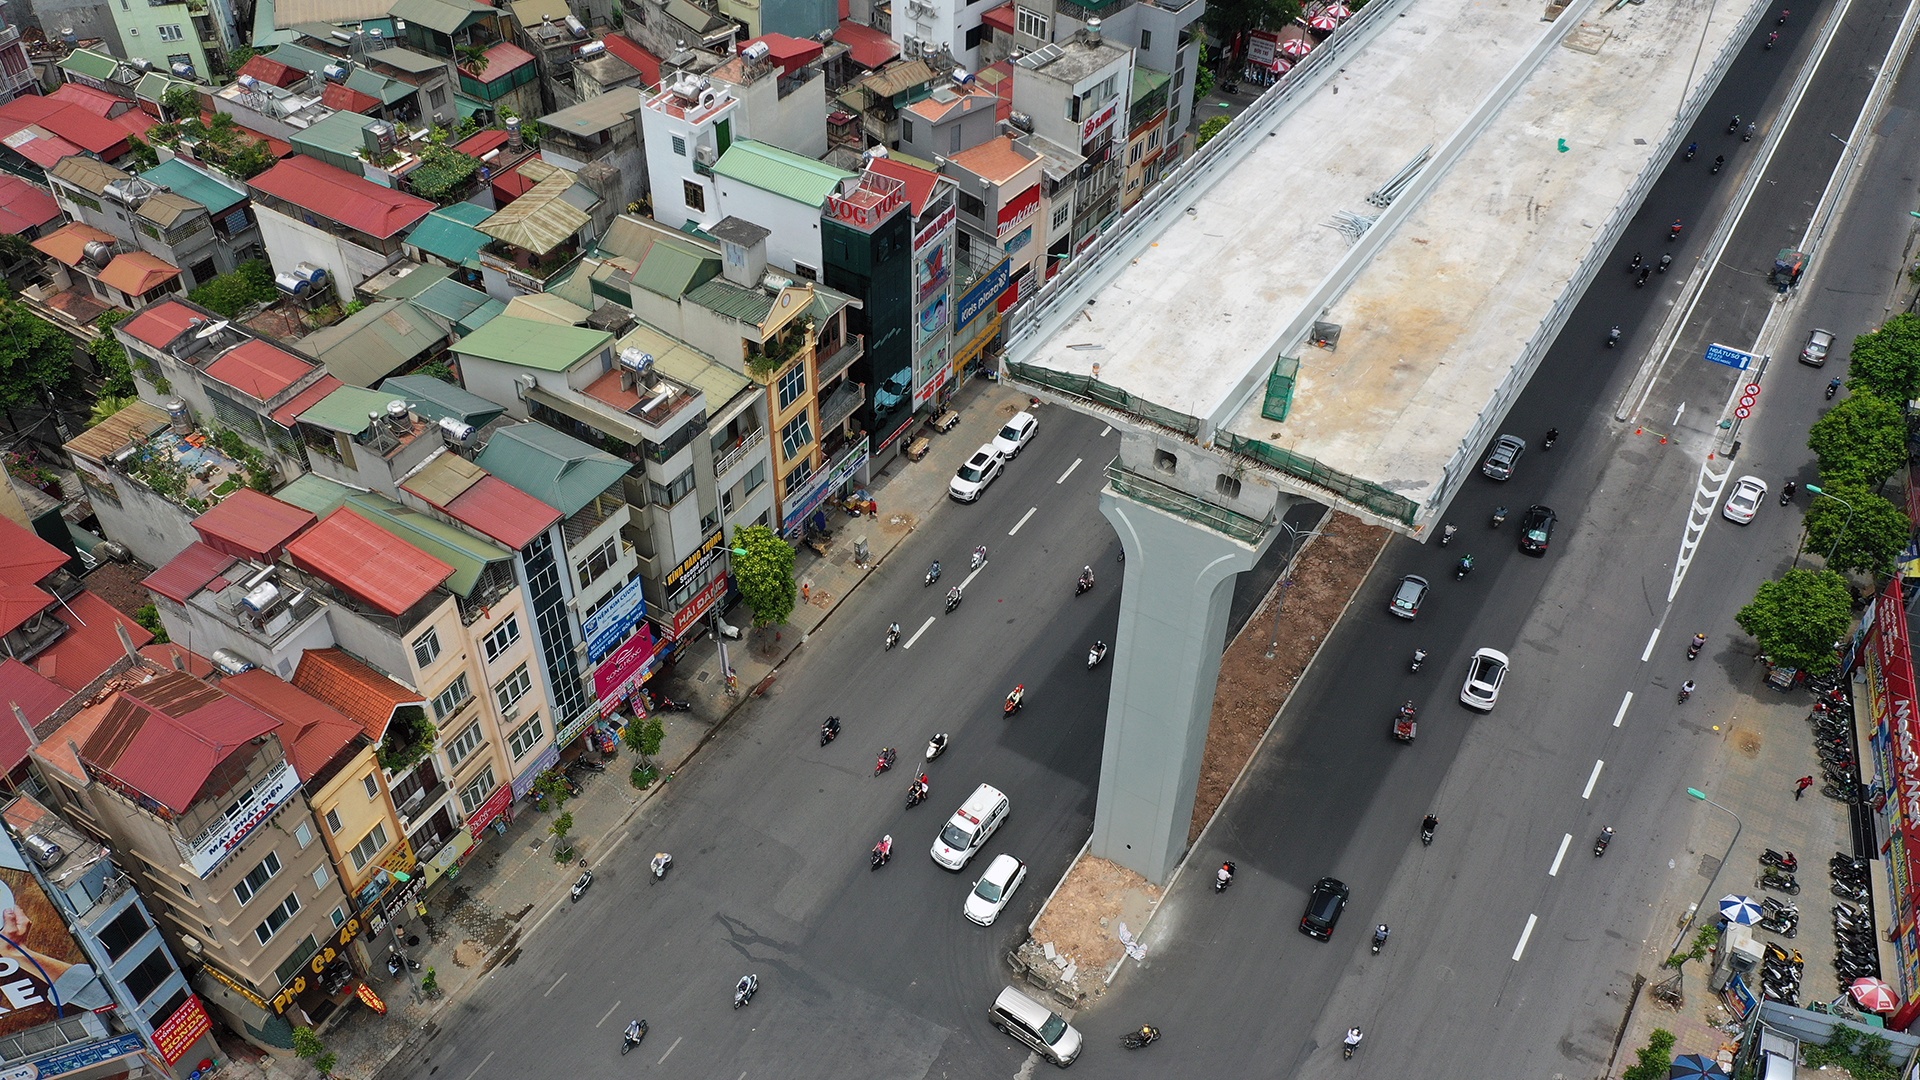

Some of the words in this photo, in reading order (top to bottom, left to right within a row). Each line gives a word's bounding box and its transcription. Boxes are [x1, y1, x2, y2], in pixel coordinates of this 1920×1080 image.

[827, 196, 866, 224] VOG
[874, 187, 903, 222] VOG
[678, 605, 696, 626] HẢI
[208, 830, 229, 855] MÁY
[233, 805, 259, 831] PHÁT
[261, 783, 283, 805] ĐIỆN
[223, 803, 276, 851] HONDA
[340, 917, 360, 946] 49
[162, 1014, 204, 1054] HONDA
